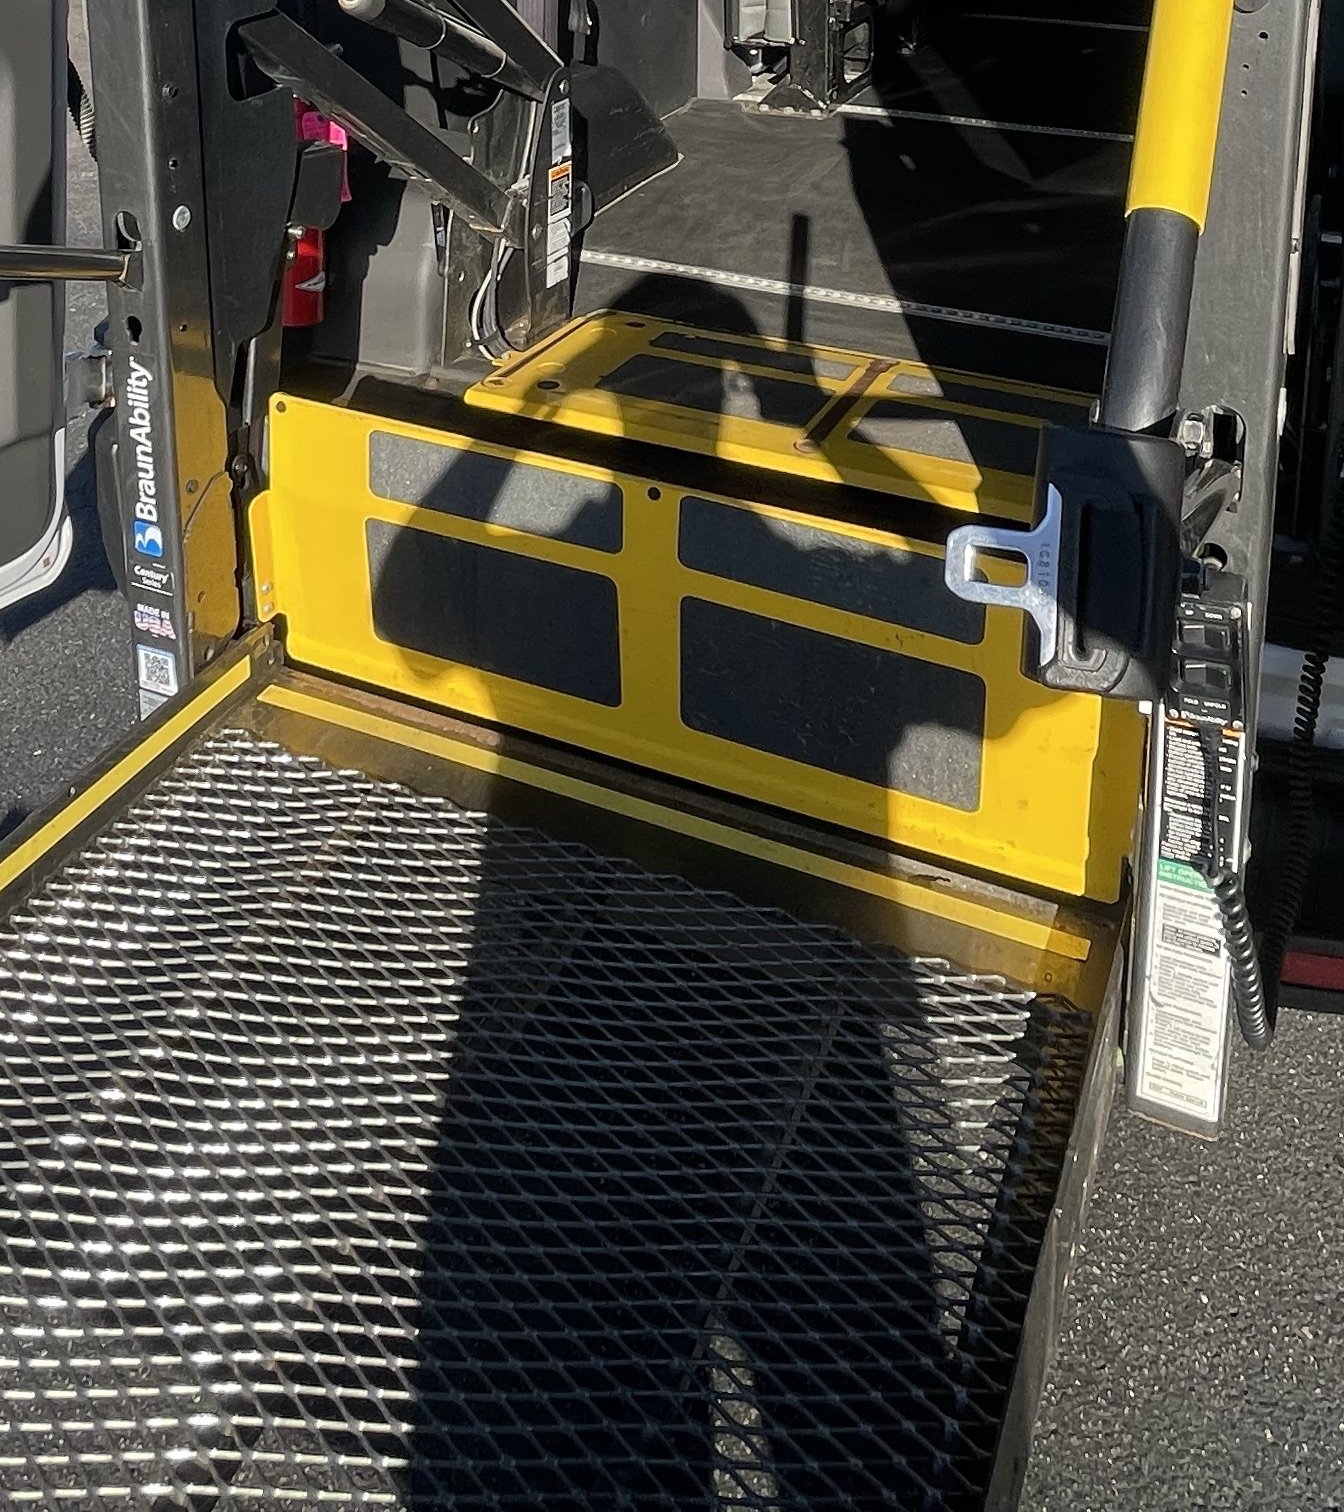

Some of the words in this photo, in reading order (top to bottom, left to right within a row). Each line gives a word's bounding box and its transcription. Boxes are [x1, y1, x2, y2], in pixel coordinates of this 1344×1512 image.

[127, 354, 158, 521] BraunAbility
[133, 564, 170, 584] Century
[136, 603, 160, 618] MADE
[160, 609, 170, 620] IN
